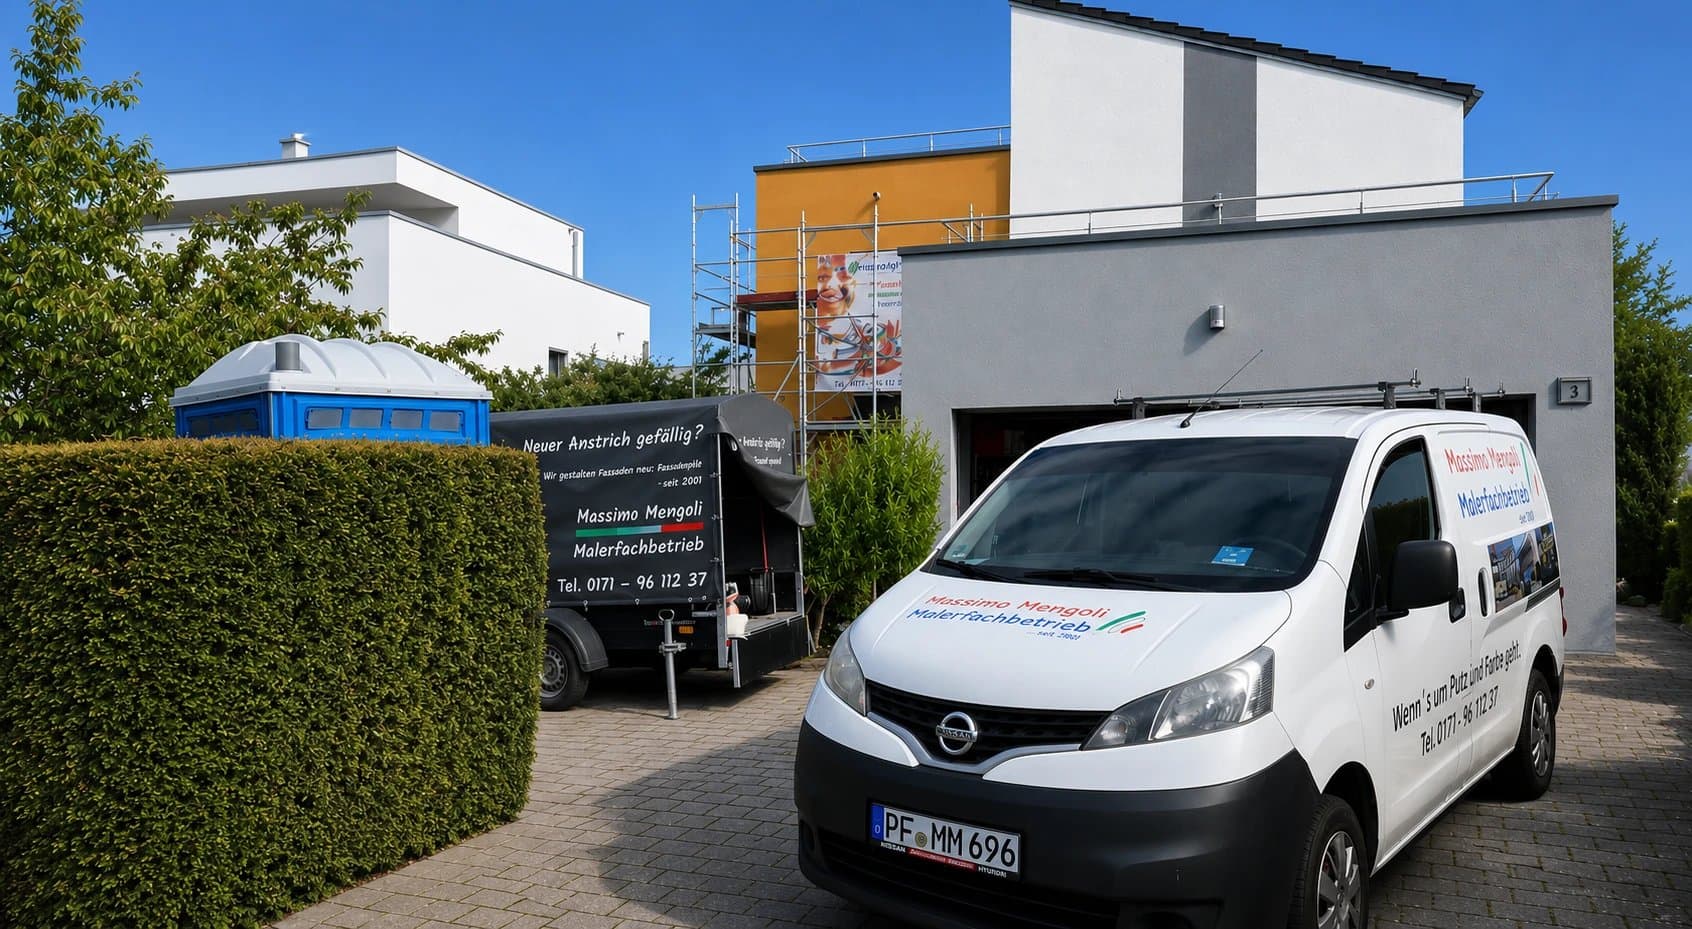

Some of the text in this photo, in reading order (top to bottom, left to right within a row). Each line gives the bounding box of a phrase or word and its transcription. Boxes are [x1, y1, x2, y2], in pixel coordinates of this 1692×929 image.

[1570, 385, 1578, 399] 3
[523, 424, 704, 453] Neuer Anstrich gefällig?
[543, 471, 557, 480] Wir
[598, 466, 634, 477] Fassaden
[1444, 447, 1489, 474] Massimo
[681, 475, 702, 486] 2001
[577, 500, 703, 525] Massimo Mengoli
[1457, 481, 1530, 519] Malerfachbetrieb
[573, 535, 704, 559] Malerfachbetrieb
[557, 577, 582, 593] Tel.
[587, 576, 615, 592] 0171
[636, 574, 655, 591] 96
[661, 572, 682, 589] 112
[688, 571, 708, 588] 37
[924, 595, 1110, 619] Massimo Mengoli
[906, 608, 1092, 633] Malerfachbetrieb
[1392, 698, 1421, 732] Wenn
[1433, 684, 1448, 708] um
[1449, 672, 1468, 698] Putz
[1469, 658, 1484, 687] und
[1485, 649, 1504, 678] Farbe
[1505, 639, 1522, 672] geht.
[1420, 726, 1436, 756] Tel.
[1437, 711, 1456, 745] 0171
[1463, 702, 1473, 727] 96
[1475, 692, 1487, 719] 112
[1488, 685, 1499, 711] 37
[886, 811, 914, 842] PF
[931, 822, 963, 857] MM
[968, 832, 1016, 868] 696
